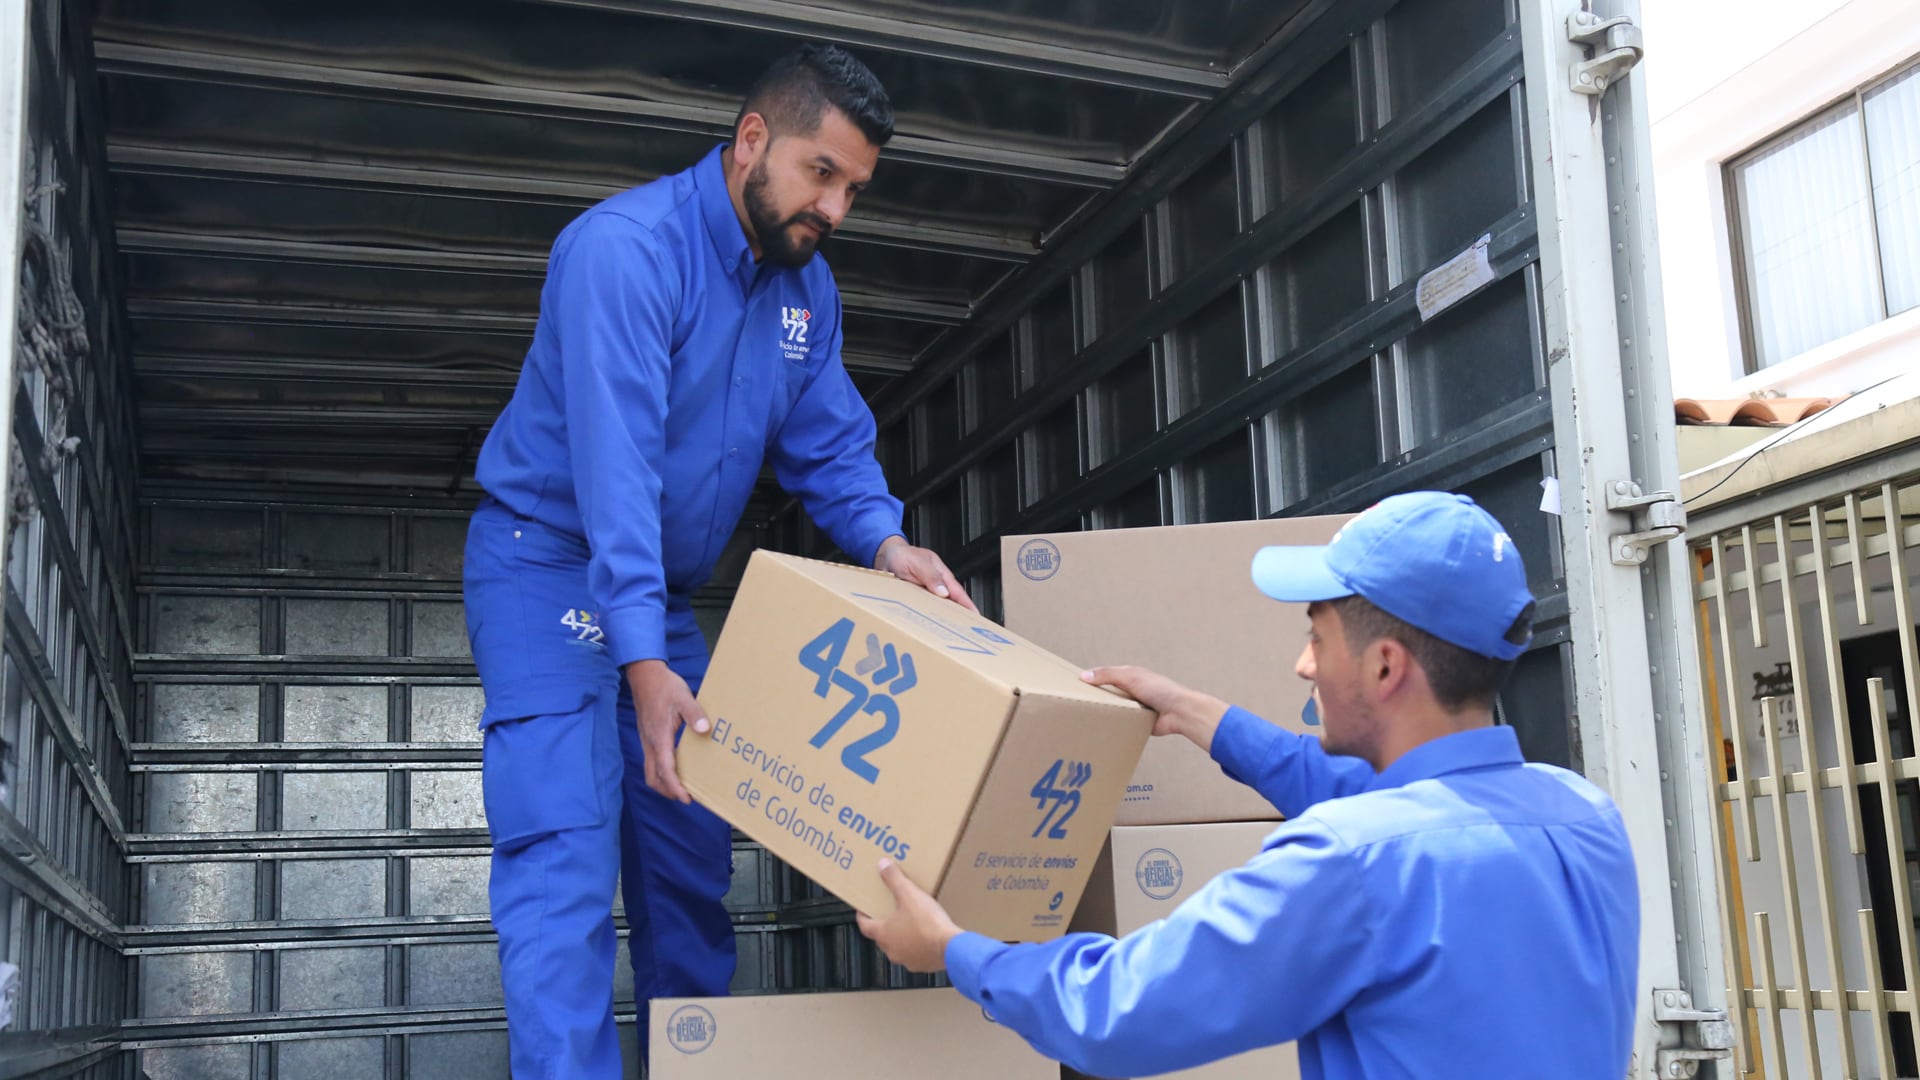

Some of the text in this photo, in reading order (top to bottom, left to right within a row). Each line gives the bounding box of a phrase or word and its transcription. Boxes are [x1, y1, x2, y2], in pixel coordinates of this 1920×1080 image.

[711, 717, 911, 861] El servicio de envíos
[1126, 784, 1154, 793] om.co
[736, 778, 854, 870] de Colombia
[974, 852, 987, 868] El
[986, 853, 1027, 869] servicio
[1028, 853, 1042, 869] de
[1145, 866, 1174, 881] OFICIAL
[987, 874, 1050, 890] de Colombia
[677, 1023, 706, 1034] OFICIAL
